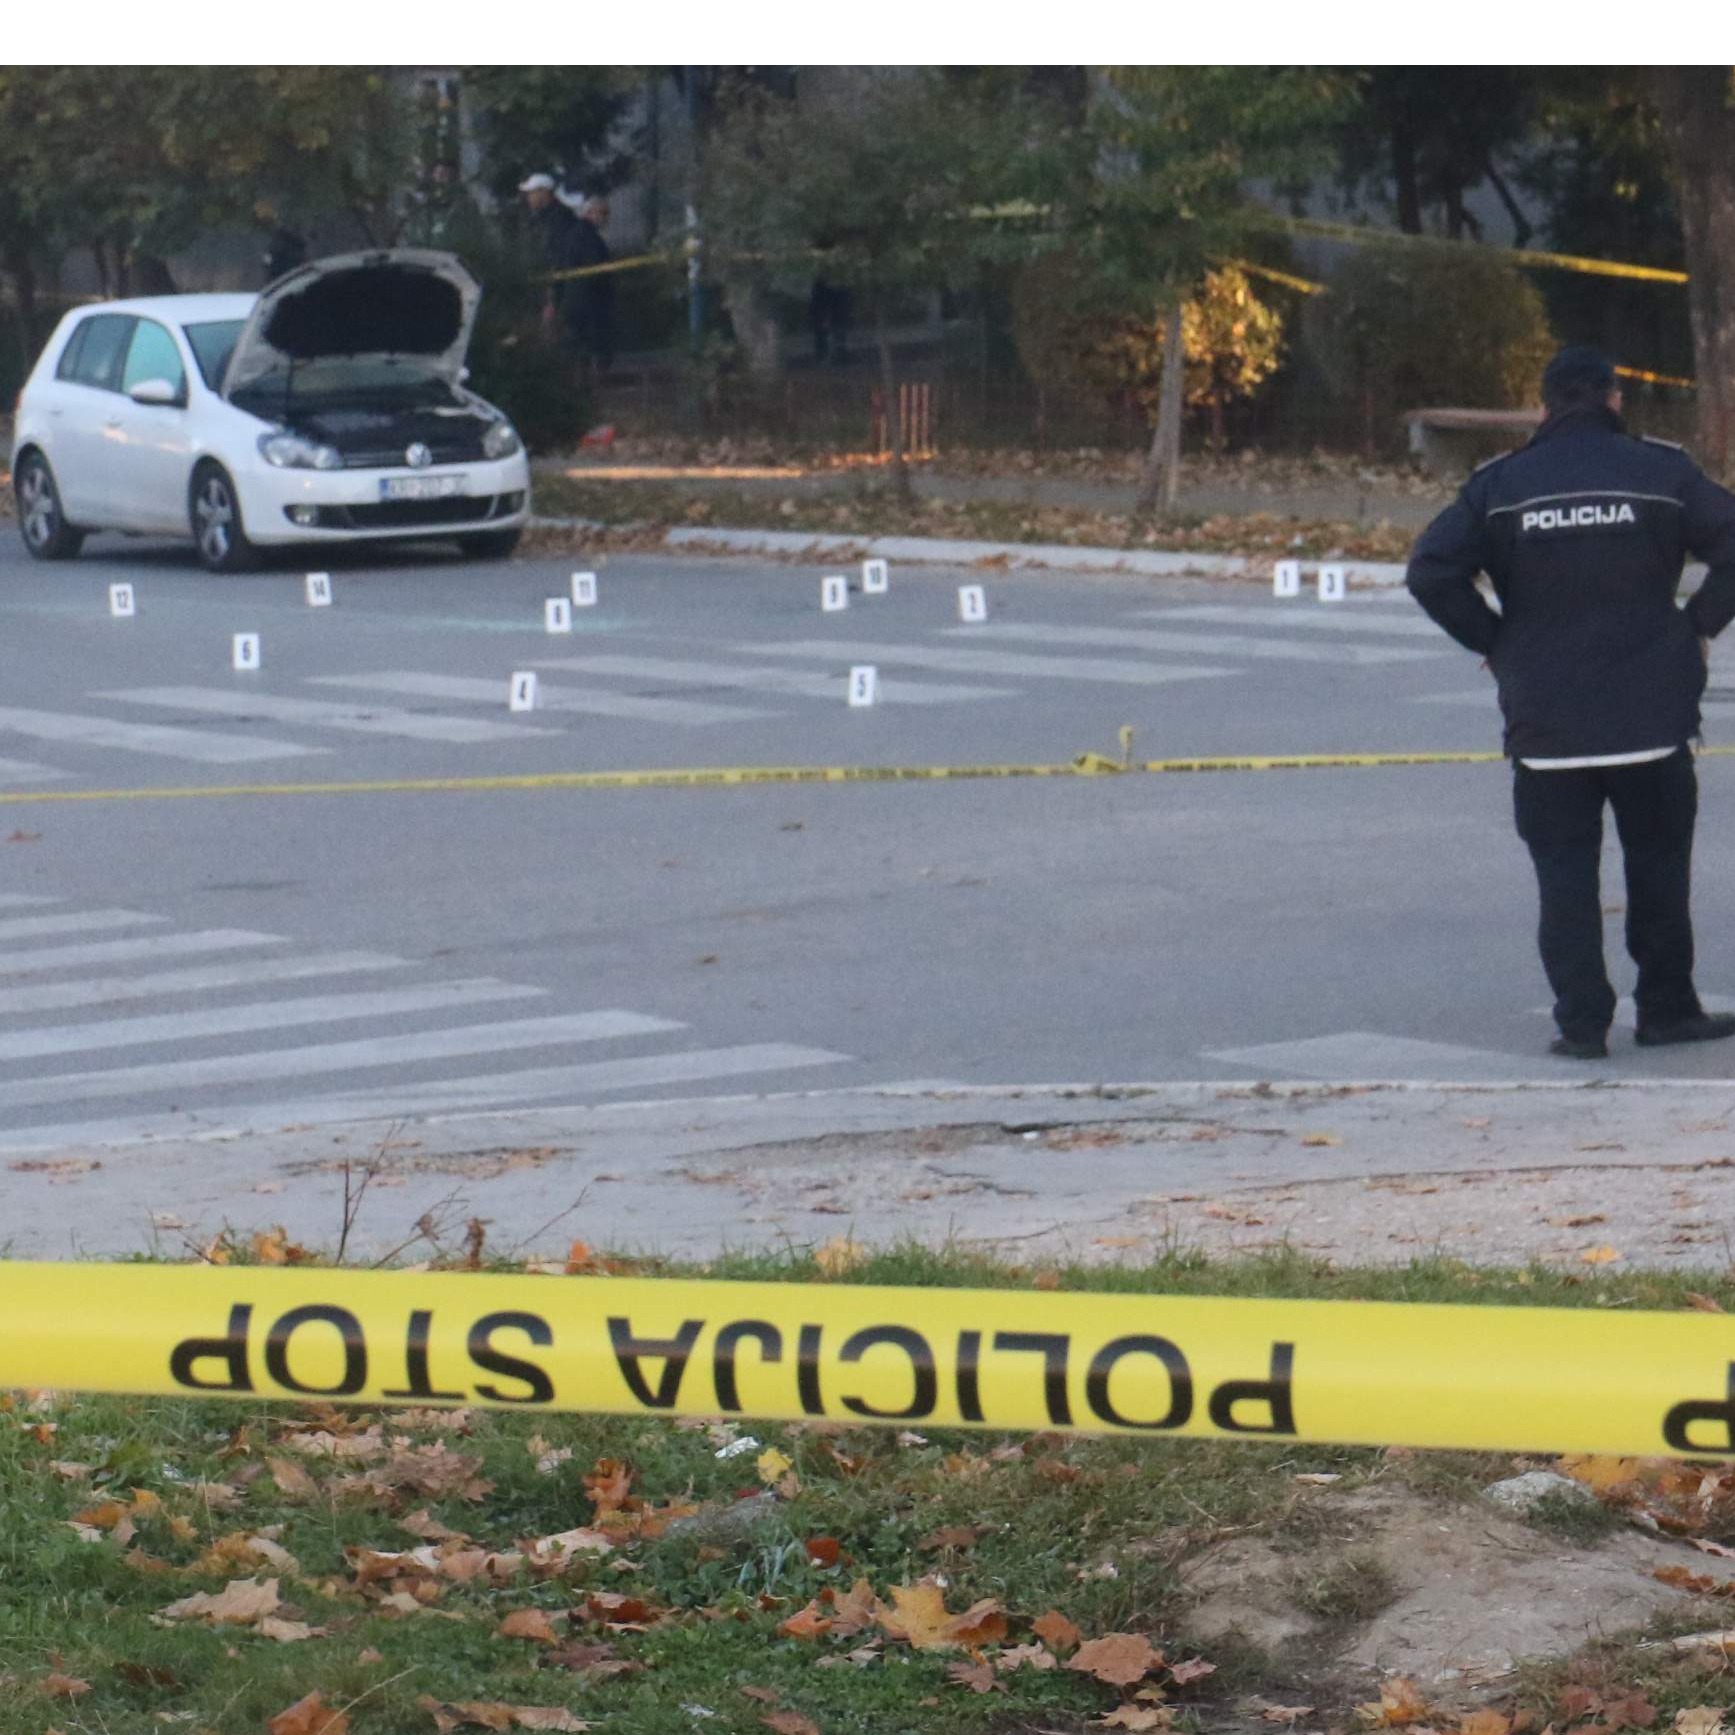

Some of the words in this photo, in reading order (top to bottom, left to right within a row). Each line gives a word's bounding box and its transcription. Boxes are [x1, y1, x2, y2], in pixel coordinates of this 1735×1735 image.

[1522, 503, 1635, 531] POLICIJA
[170, 1302, 555, 1404] STOP
[607, 1316, 1298, 1436] POLICIJA
